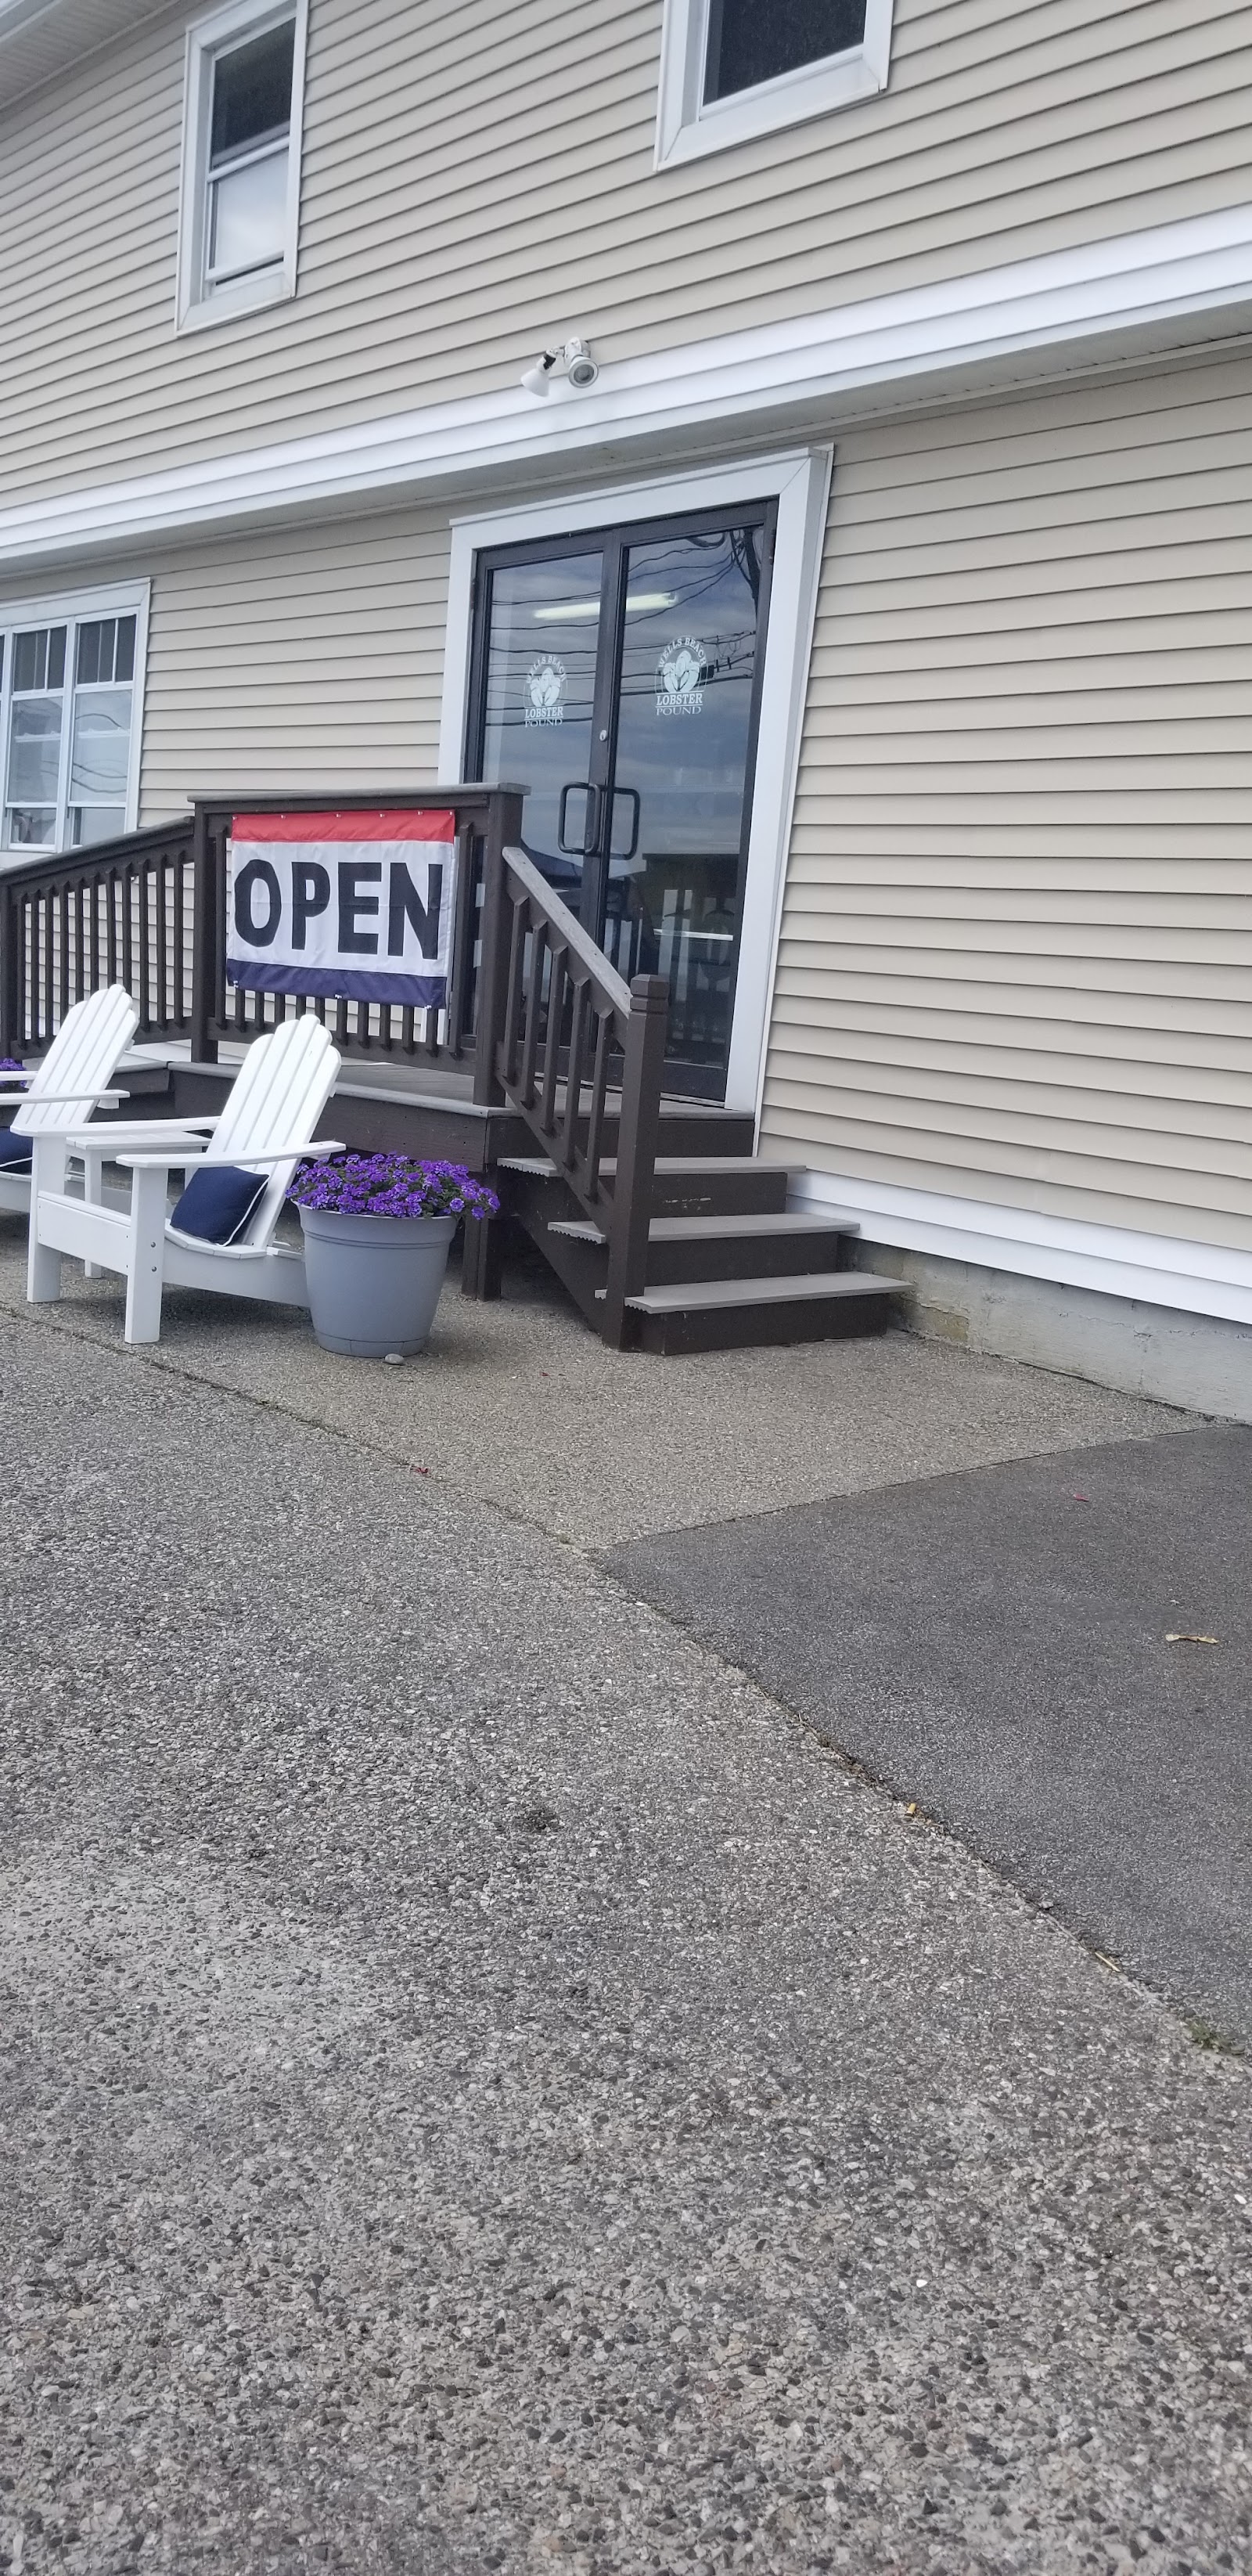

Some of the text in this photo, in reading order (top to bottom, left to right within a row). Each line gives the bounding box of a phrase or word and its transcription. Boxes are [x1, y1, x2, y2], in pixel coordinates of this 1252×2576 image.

[658, 637, 707, 667] WELLS BEACH
[657, 694, 703, 705] LOBSTER
[525, 706, 563, 718] LOBSTER
[657, 707, 701, 715] POUND
[525, 719, 563, 728] POUND
[234, 859, 443, 960] OPEN
